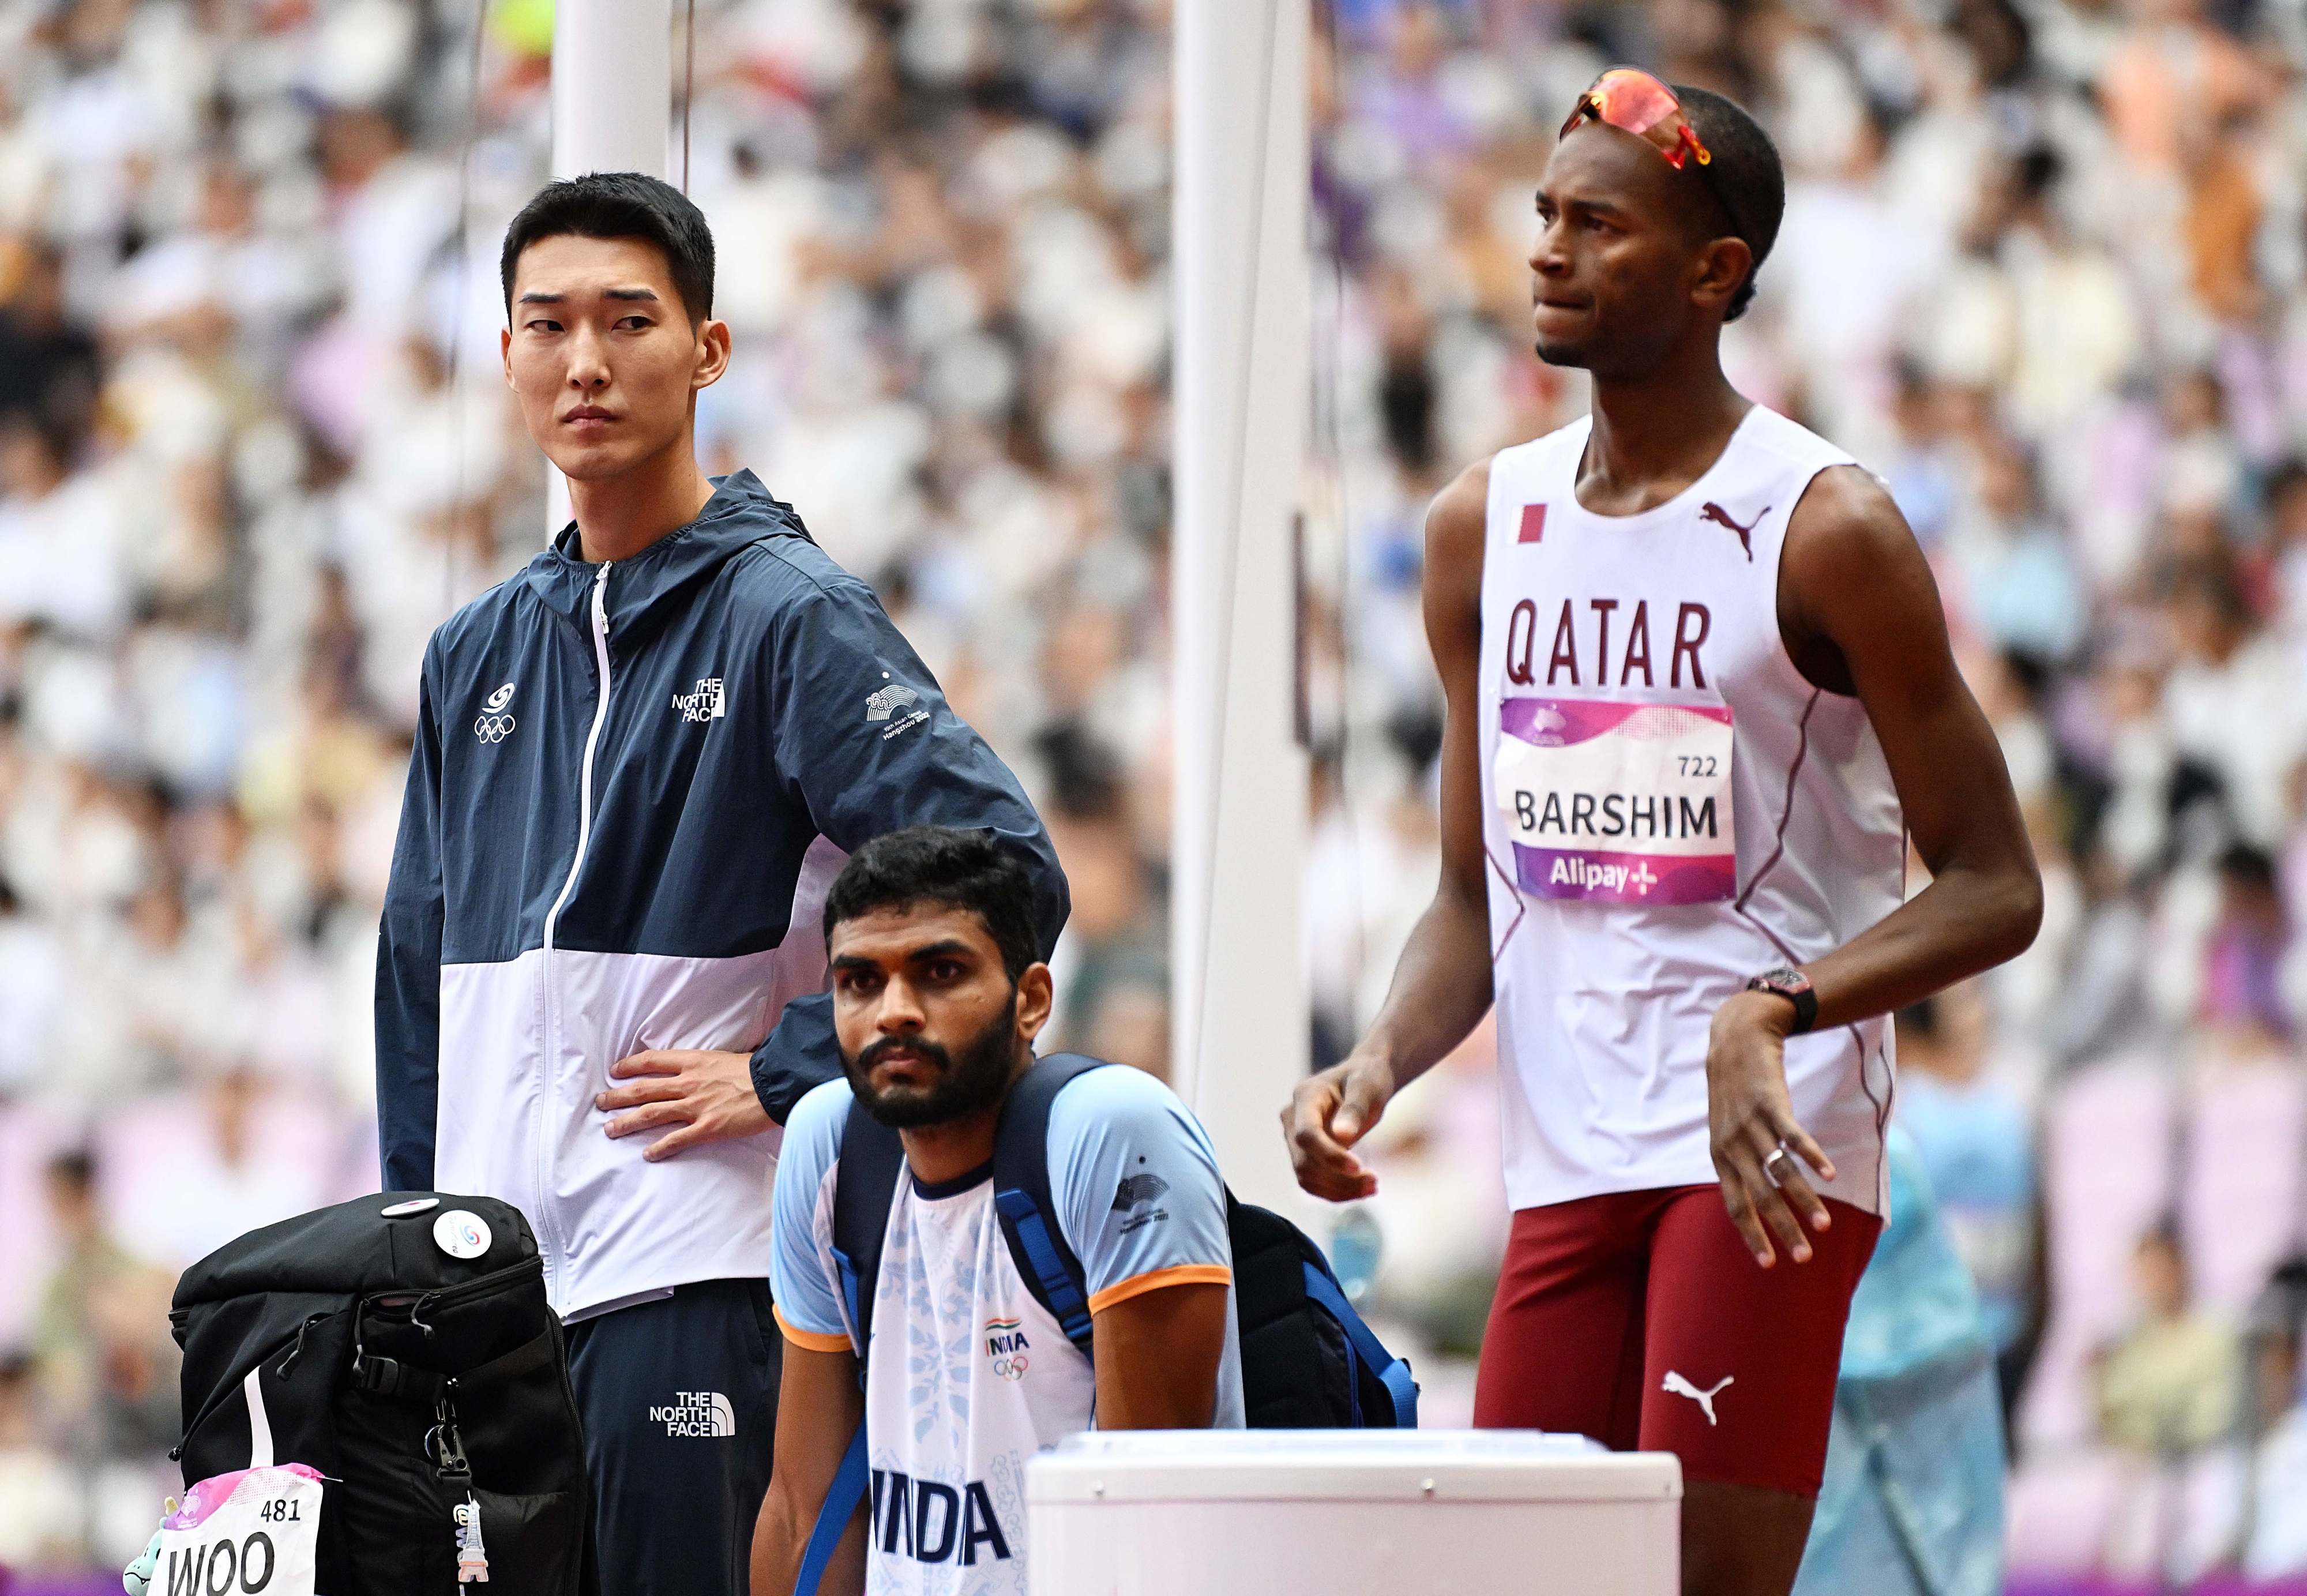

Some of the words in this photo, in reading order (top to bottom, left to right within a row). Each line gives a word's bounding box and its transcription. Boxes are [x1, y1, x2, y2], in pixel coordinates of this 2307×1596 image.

[1506, 598, 1712, 689] QATAR
[696, 678, 722, 693] THE
[671, 693, 719, 709] NORTH
[882, 719, 915, 741] Hangzhou
[915, 712, 930, 722] 2022
[884, 722, 895, 732] 19th
[895, 717, 908, 726] Asian
[907, 710, 922, 719] Games
[1678, 756, 1718, 778] 722
[1515, 789, 1719, 839] BARSHIM
[985, 1332, 1029, 1357] INDIA
[676, 1391, 711, 1407] THE
[649, 1406, 710, 1422] NORTH
[667, 1422, 711, 1437] FACE
[261, 1499, 301, 1523] 481
[168, 1531, 275, 1596] WOO
